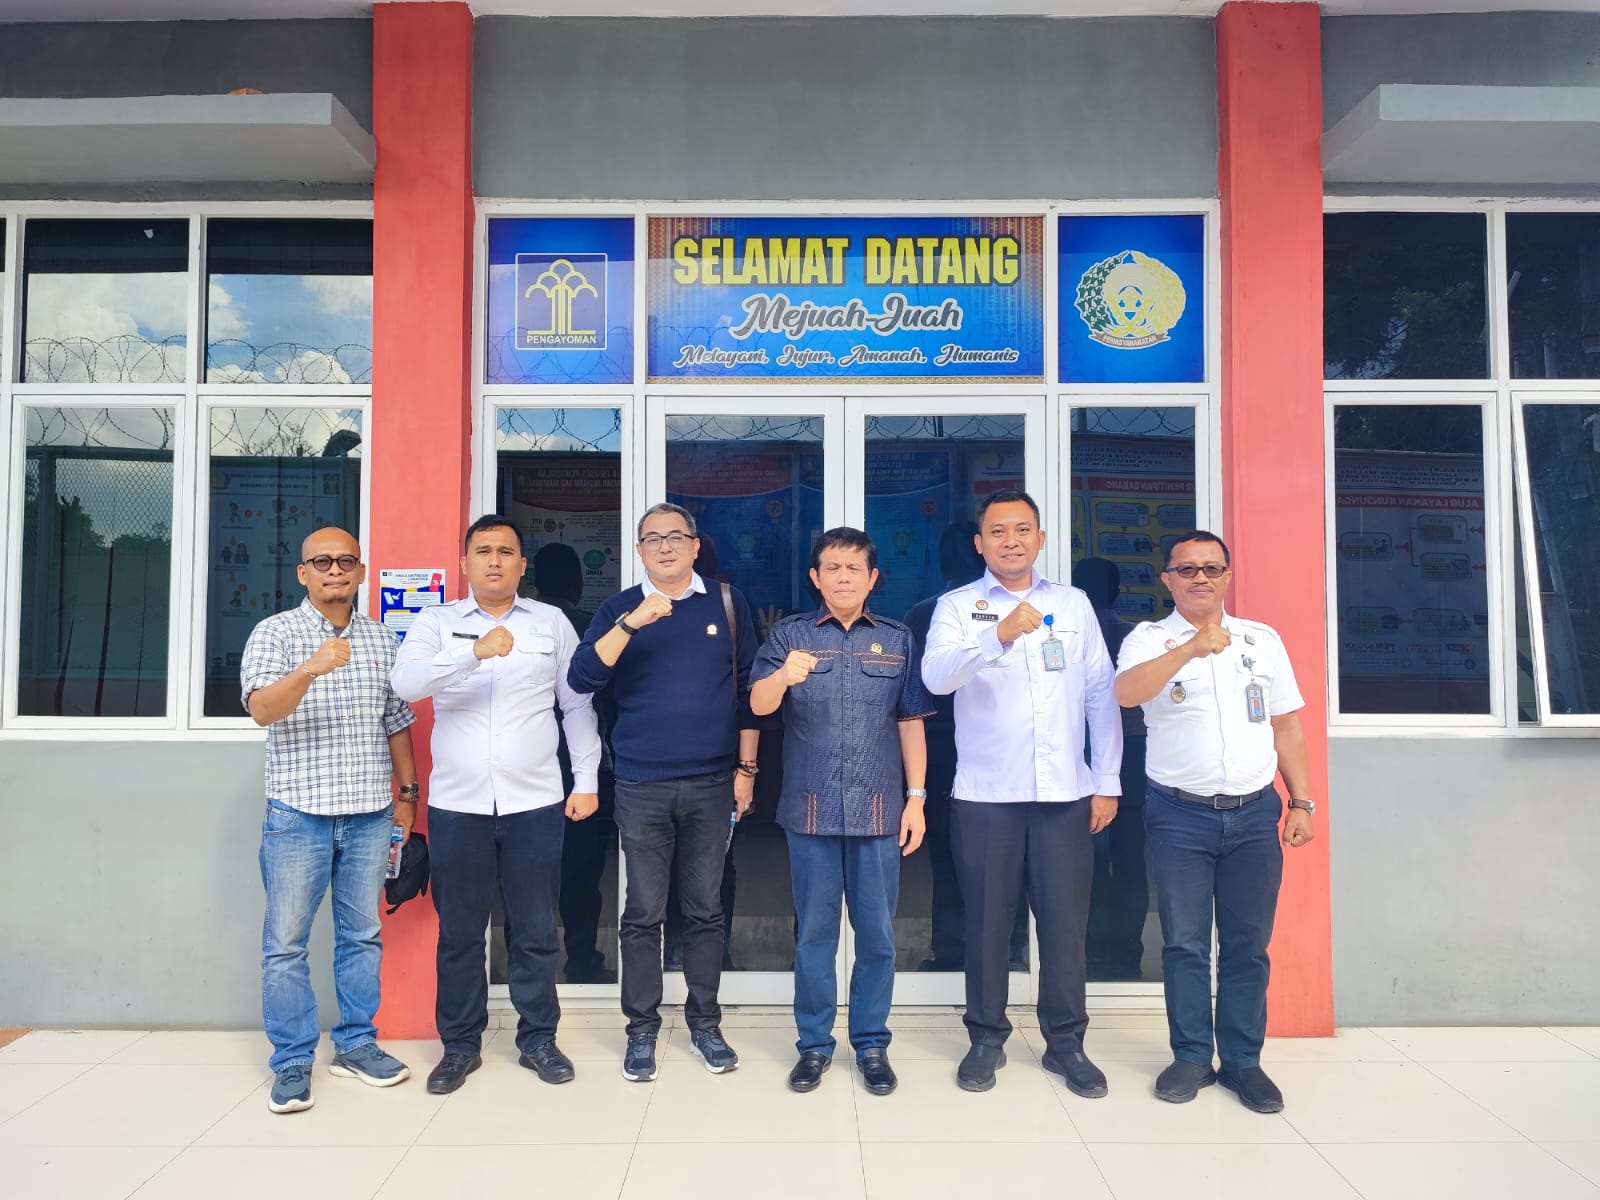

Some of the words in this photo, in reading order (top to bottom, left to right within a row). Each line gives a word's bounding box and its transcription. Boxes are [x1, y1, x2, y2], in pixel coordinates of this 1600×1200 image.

[673, 237, 849, 285] SELAMAT
[865, 237, 1019, 285] DATANG
[731, 295, 961, 338] Mejuah-Juah
[526, 335, 597, 344] PENGAYOMAN
[935, 345, 1019, 366] Humanis
